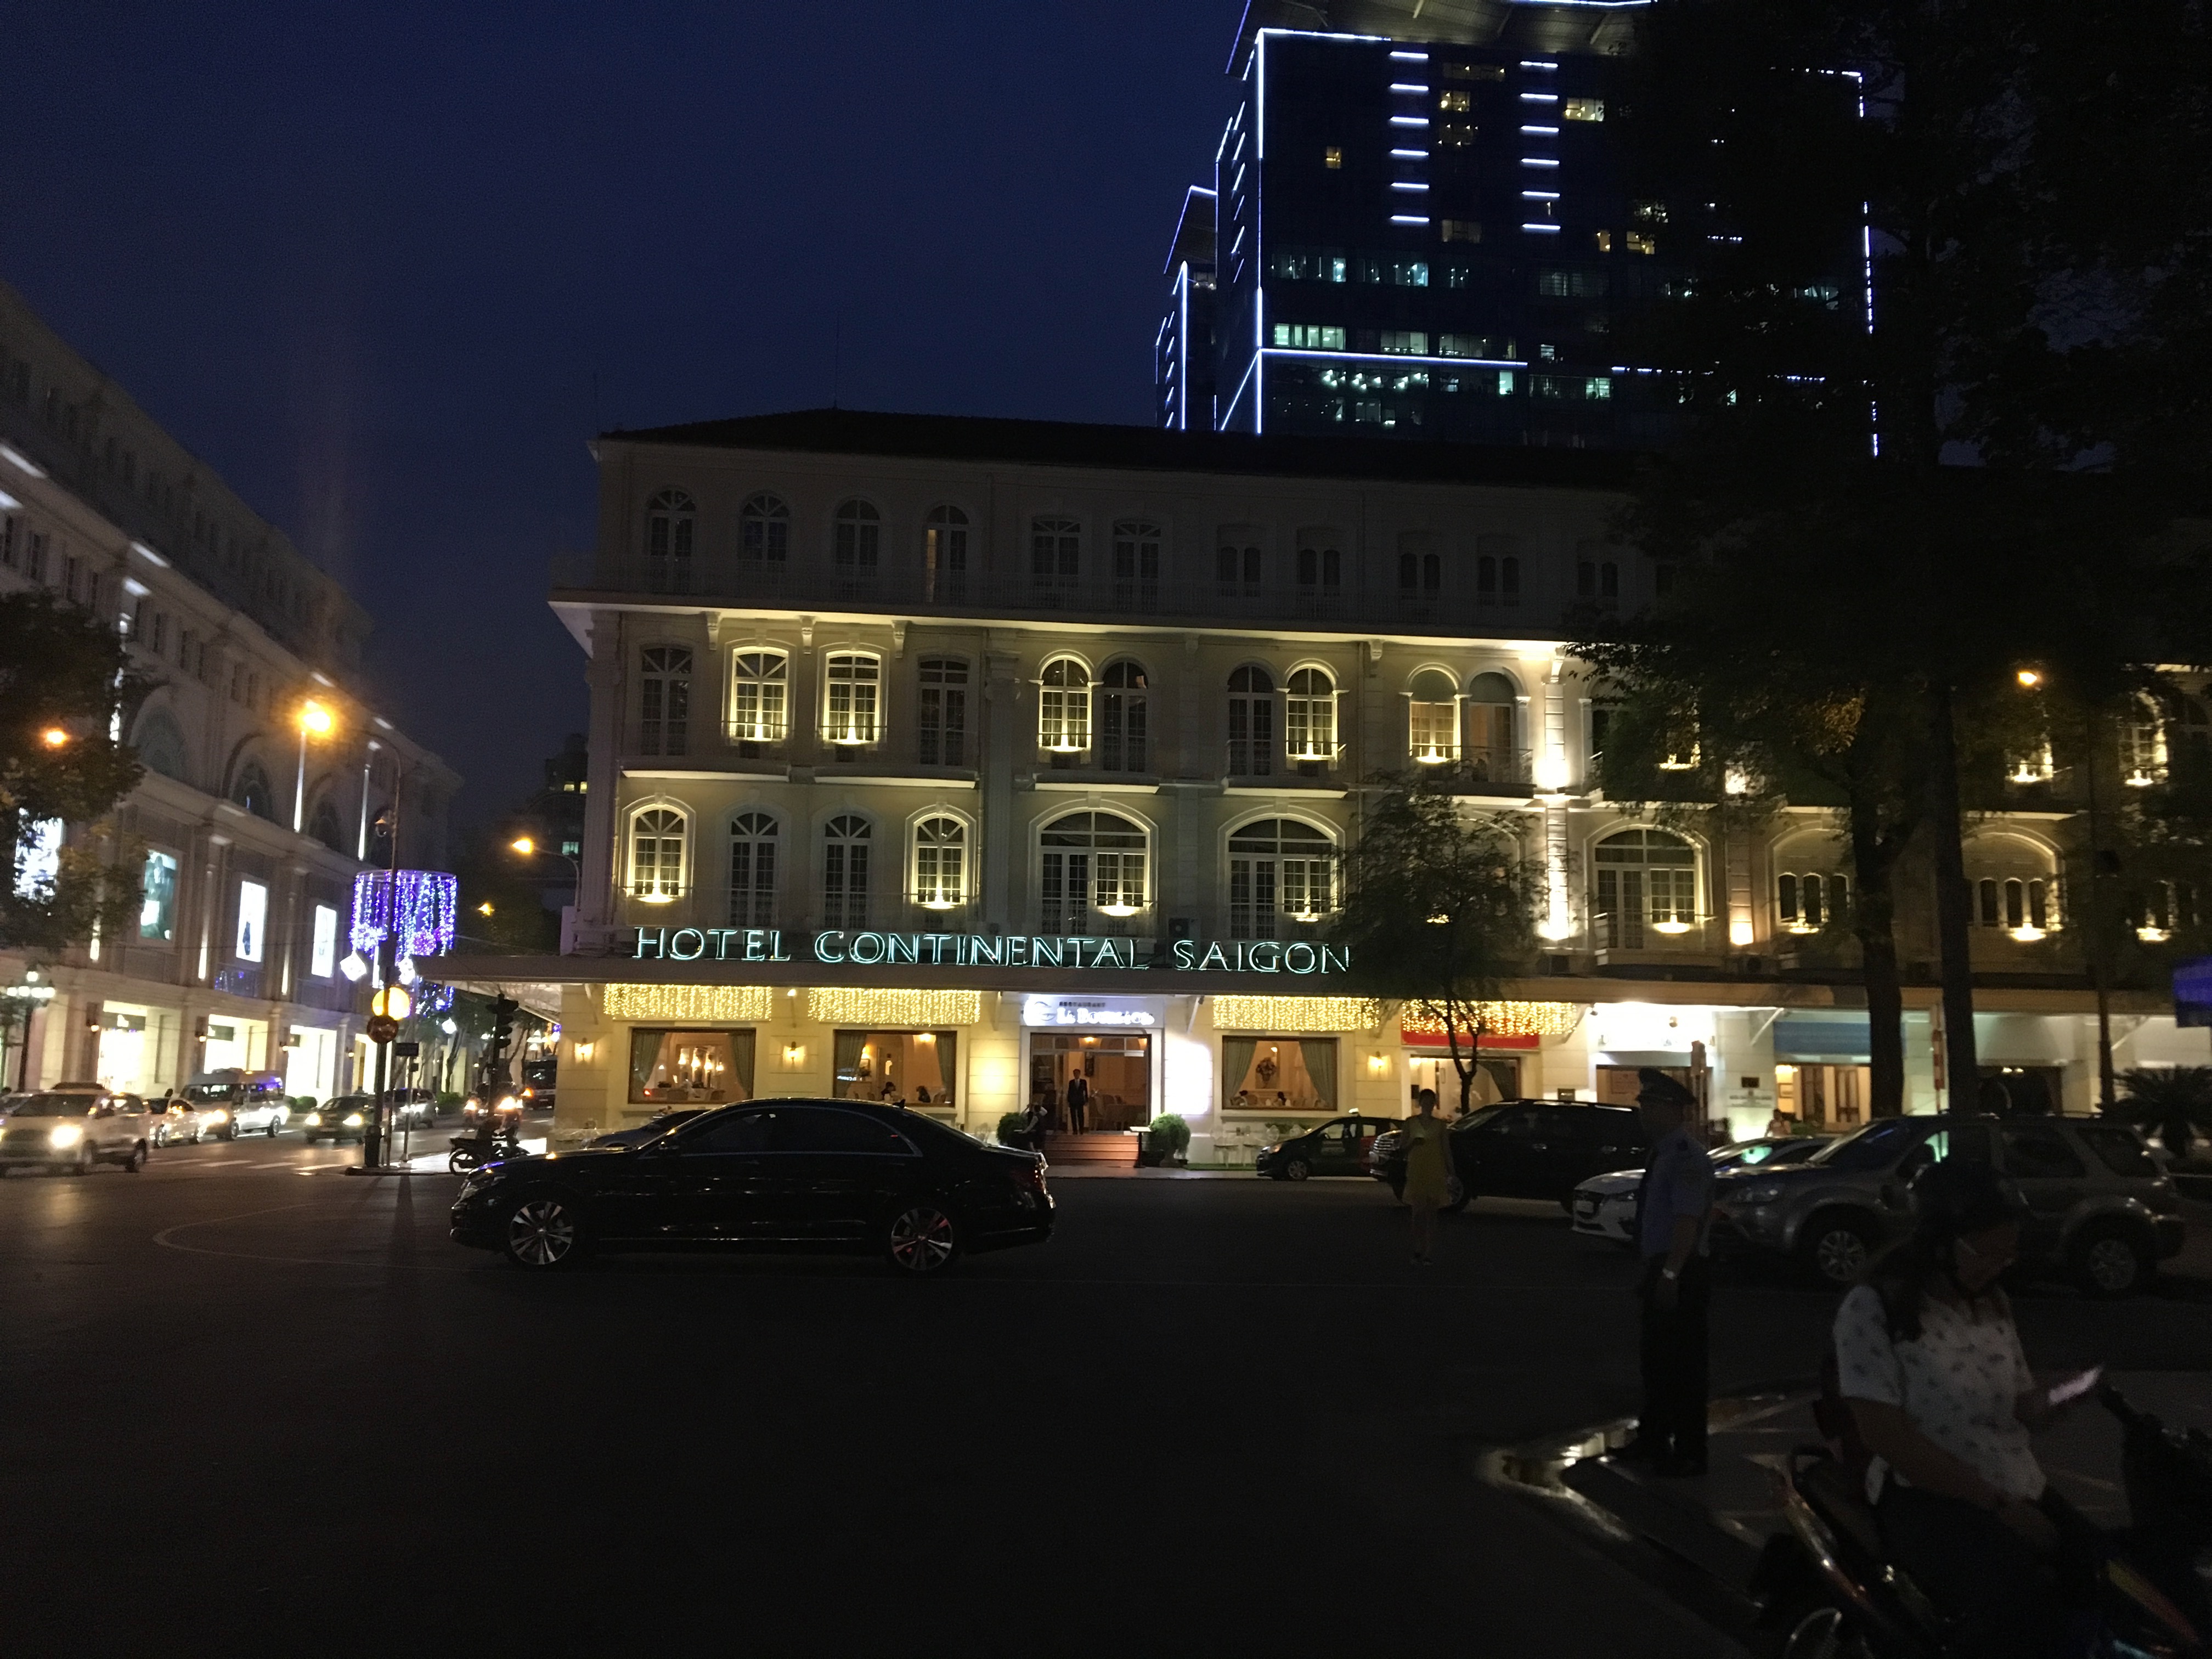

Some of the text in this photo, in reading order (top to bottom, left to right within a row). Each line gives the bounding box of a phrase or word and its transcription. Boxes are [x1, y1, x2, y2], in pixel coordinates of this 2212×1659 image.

[633, 927, 1351, 974] HOTEL CONTINENTAL SAIGON
